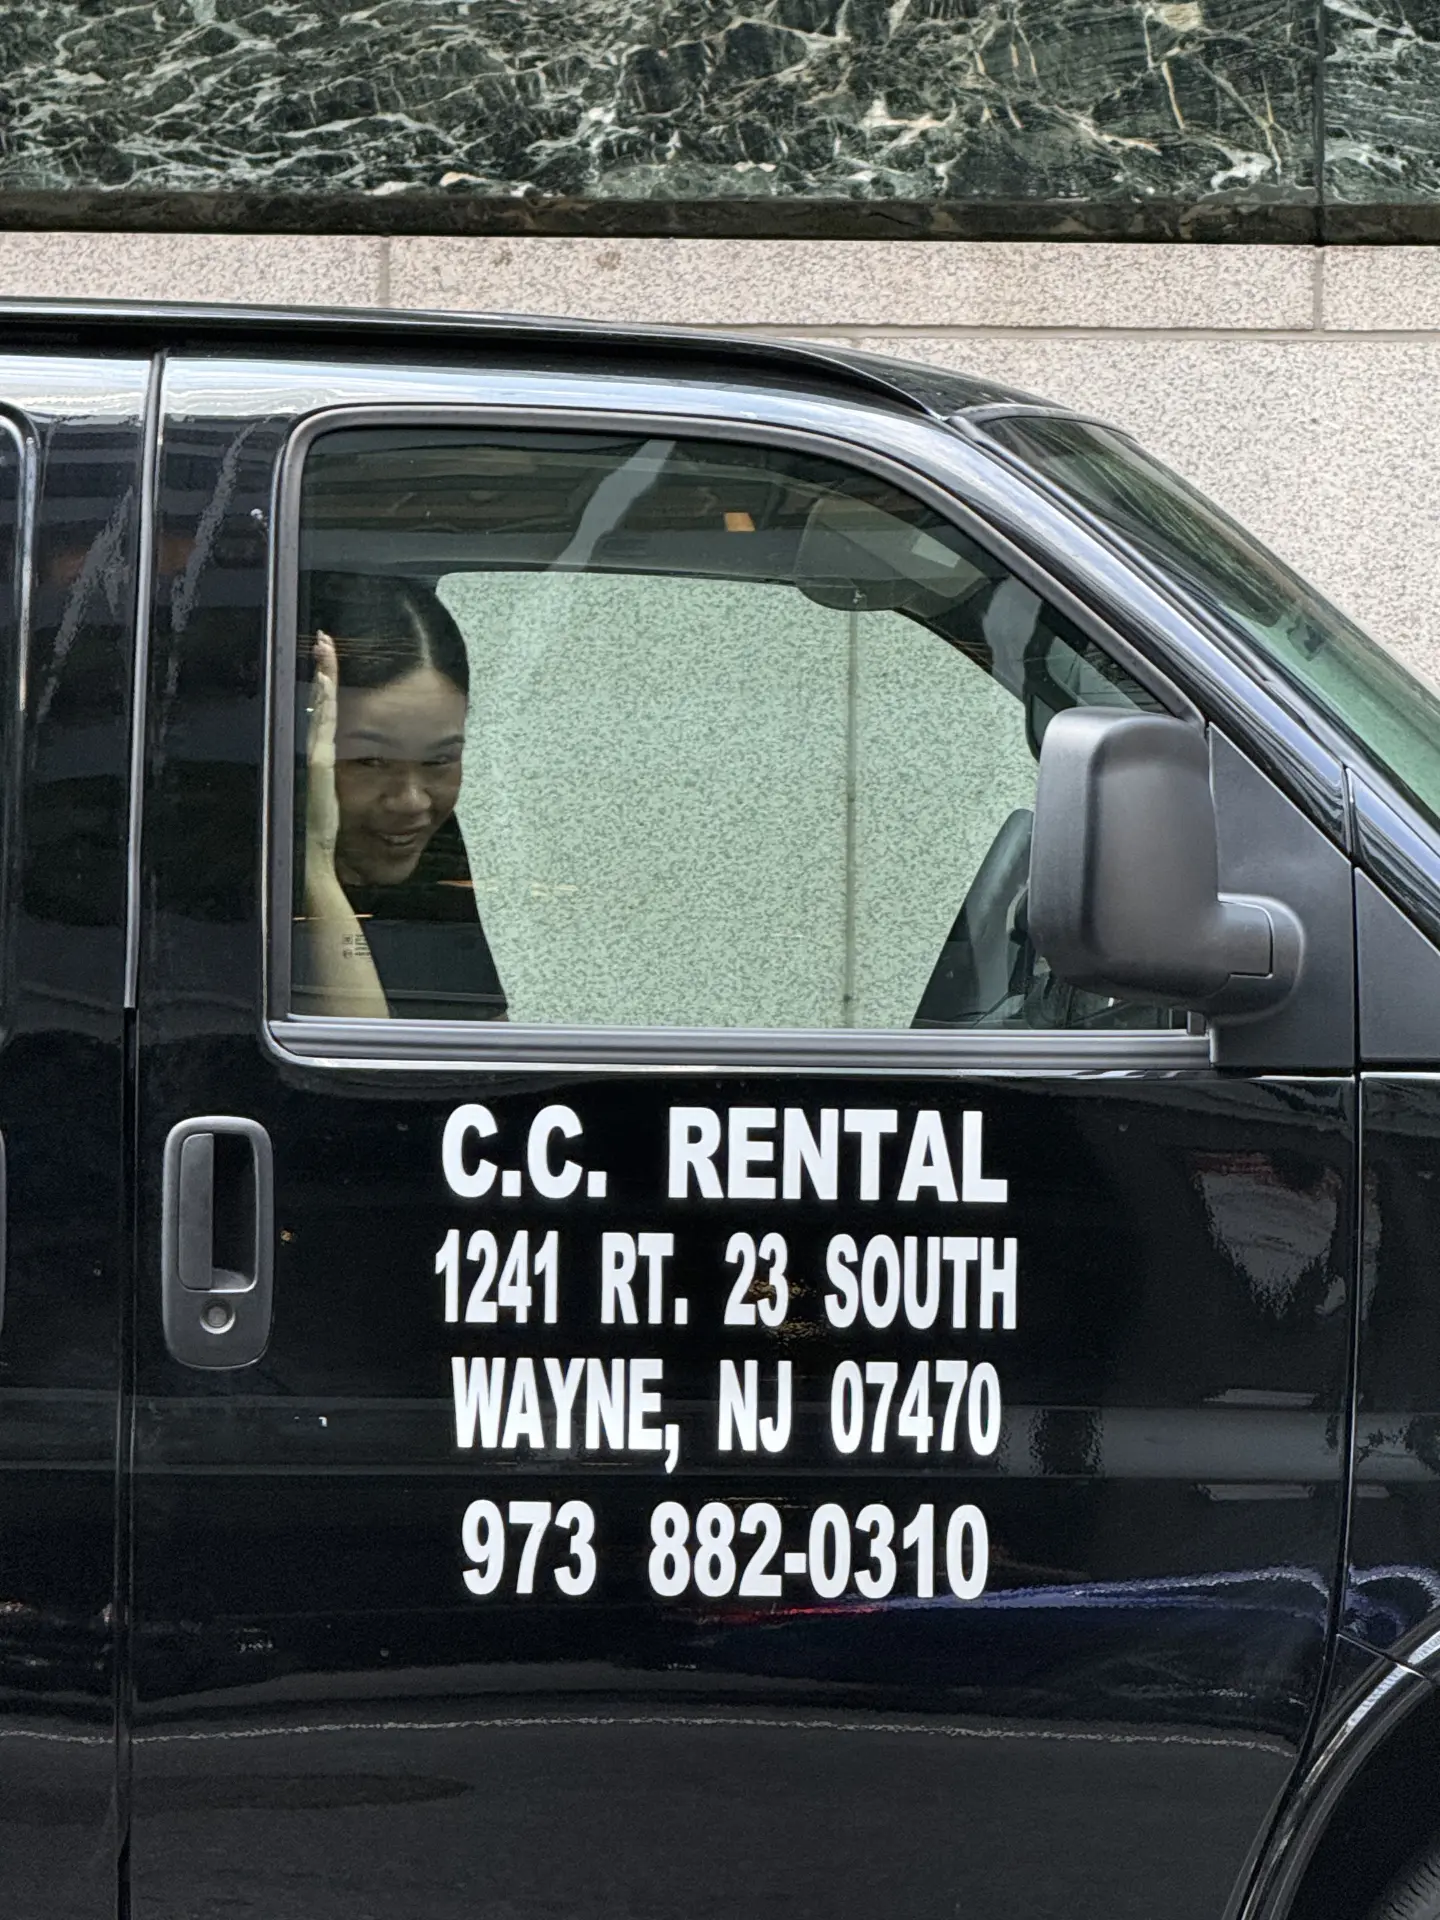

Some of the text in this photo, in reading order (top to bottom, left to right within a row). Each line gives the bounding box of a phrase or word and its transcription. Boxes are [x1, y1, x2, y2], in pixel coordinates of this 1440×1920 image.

[441, 1103, 1008, 1203] C.C. RENTAL
[435, 1228, 1018, 1330] 1241 RT. 23 SOUTH
[451, 1356, 1002, 1474] WAYNE, NJ 07470
[461, 1499, 989, 1600] 973 882-0310
